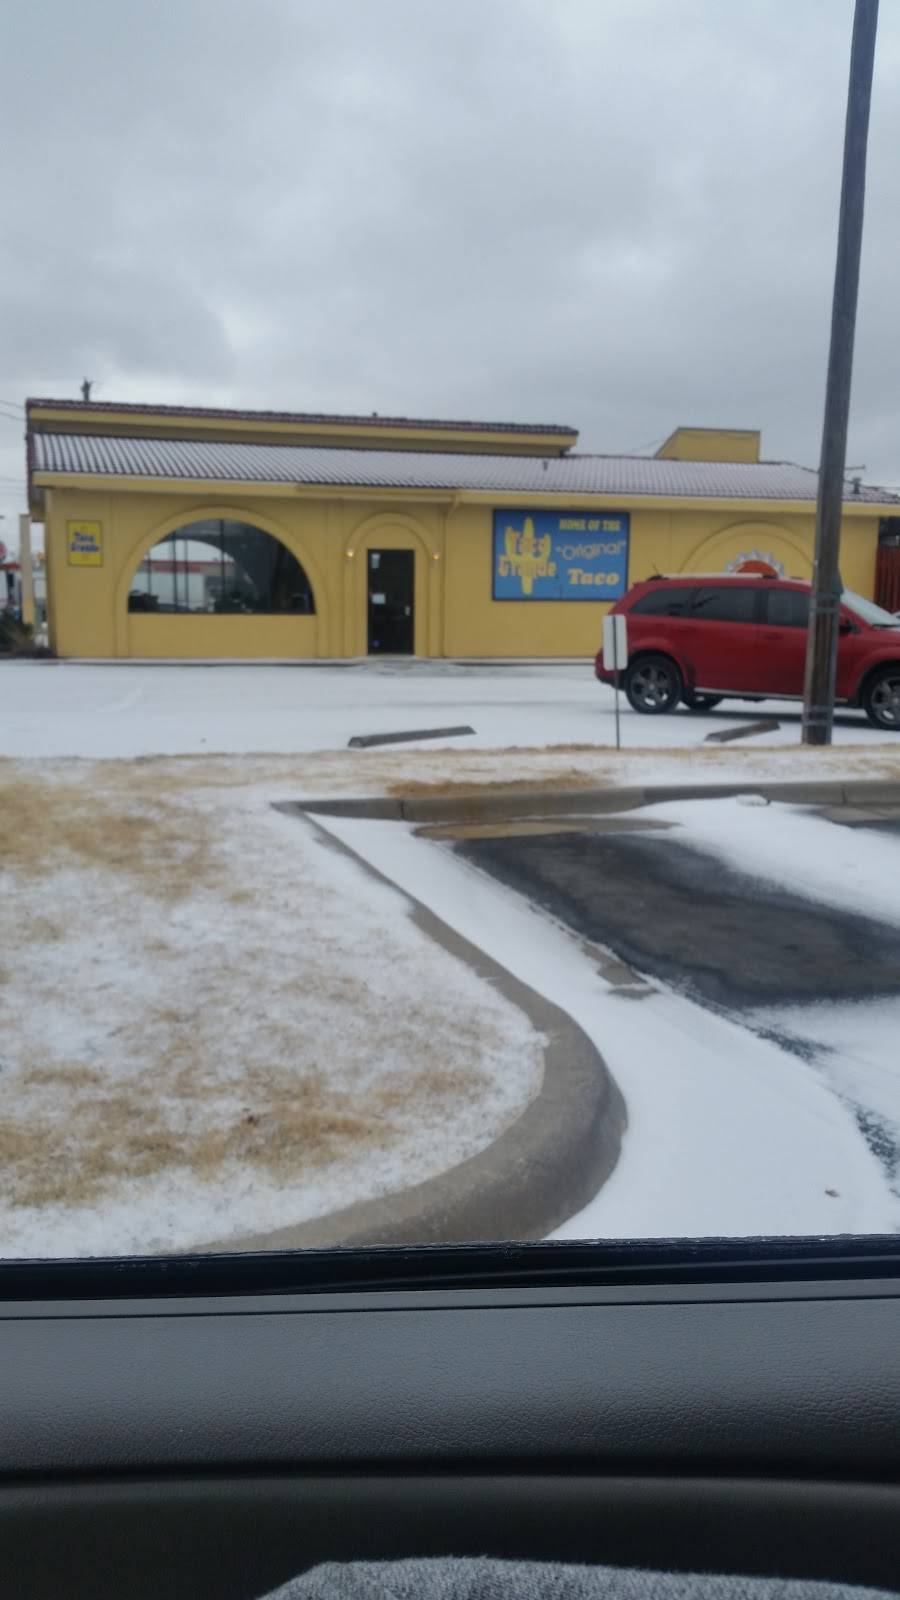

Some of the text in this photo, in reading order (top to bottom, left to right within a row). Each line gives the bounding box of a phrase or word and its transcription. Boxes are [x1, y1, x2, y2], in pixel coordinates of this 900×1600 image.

[560, 519, 621, 532] HOME OF THE
[567, 568, 620, 586] Taco
